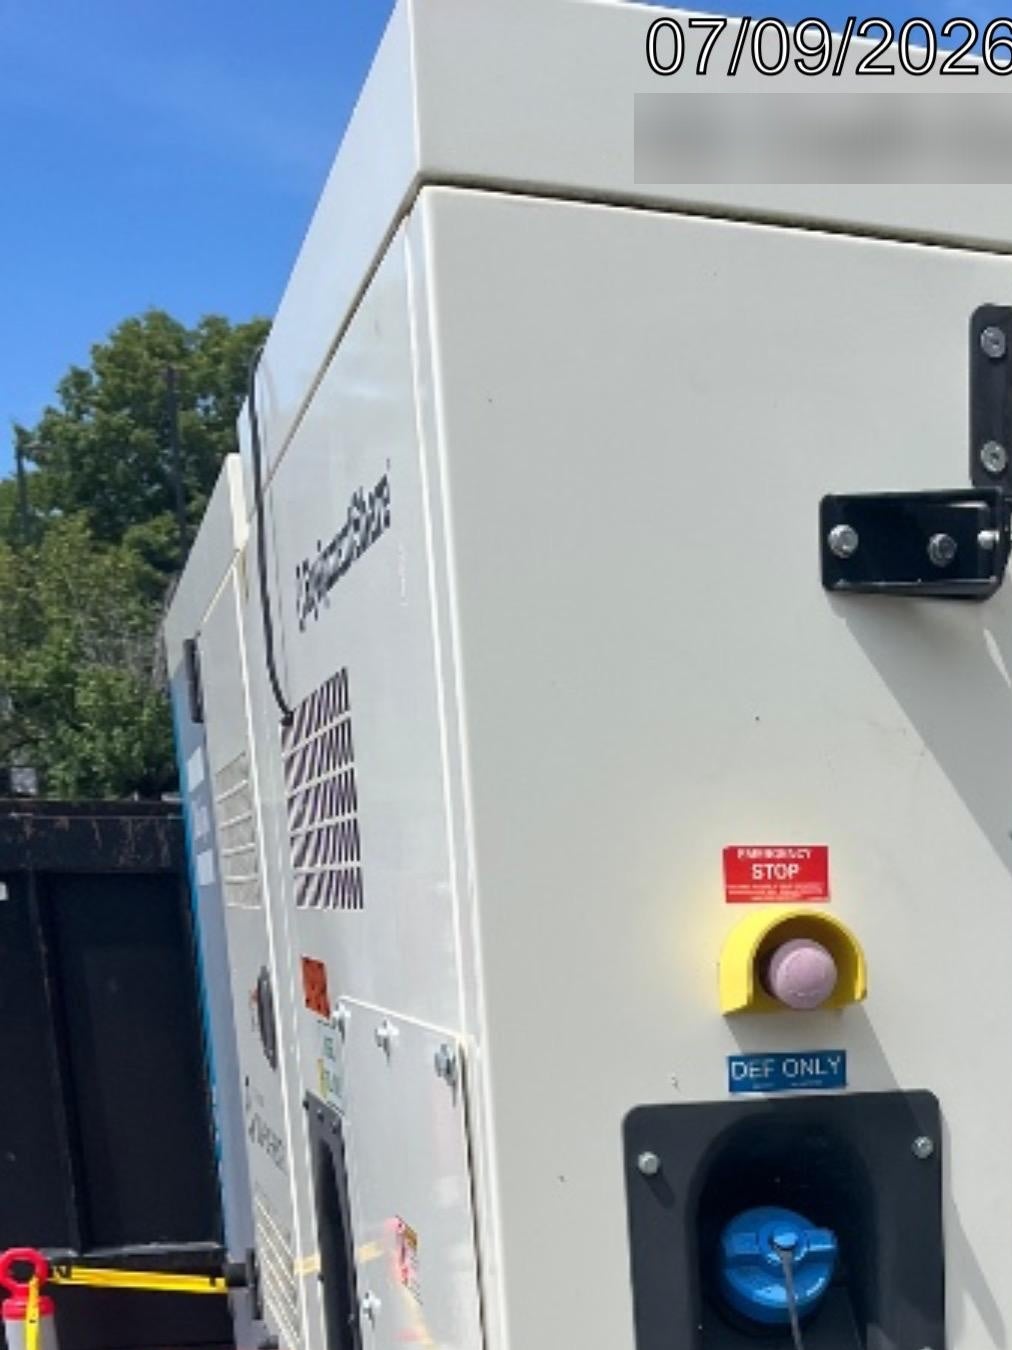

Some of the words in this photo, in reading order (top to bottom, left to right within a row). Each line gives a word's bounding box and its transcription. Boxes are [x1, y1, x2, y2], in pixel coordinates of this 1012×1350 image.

[752, 863, 800, 880] STOP
[731, 1059, 775, 1080] DEF
[782, 1055, 841, 1078] ONLY
